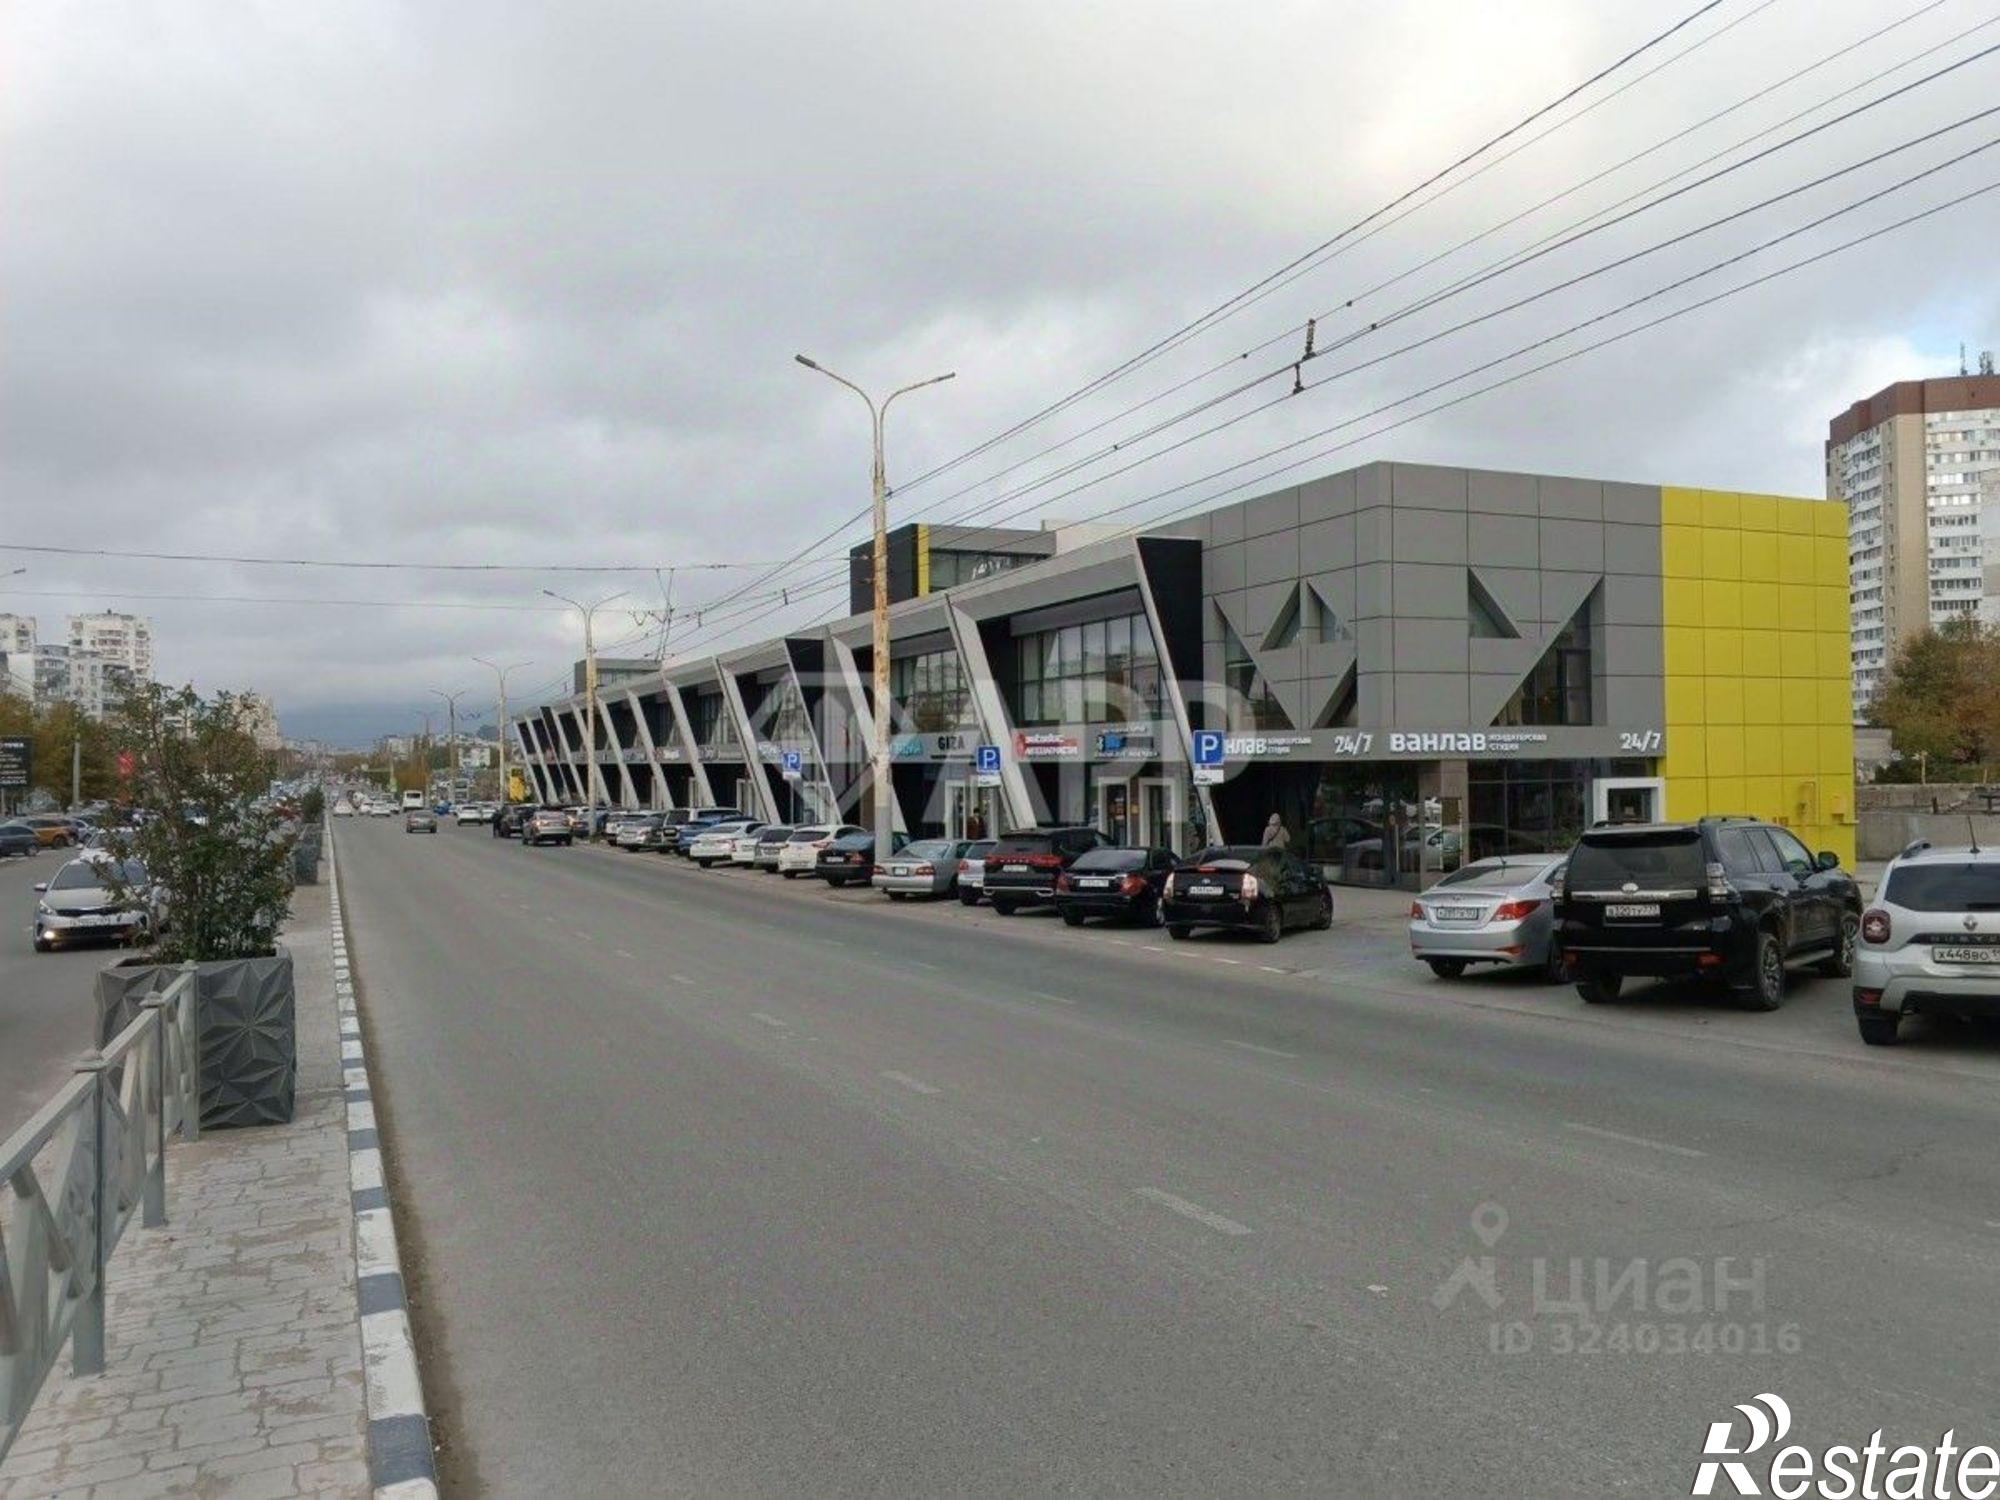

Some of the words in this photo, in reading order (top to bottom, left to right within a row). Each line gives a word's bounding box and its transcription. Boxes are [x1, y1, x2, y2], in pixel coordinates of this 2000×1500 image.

[938, 735, 965, 750] GIZA
[1224, 736, 1268, 755] нлав
[1335, 732, 1373, 756] 24/7
[1390, 732, 1486, 753] ванлав
[1619, 729, 1661, 753] 24/7
